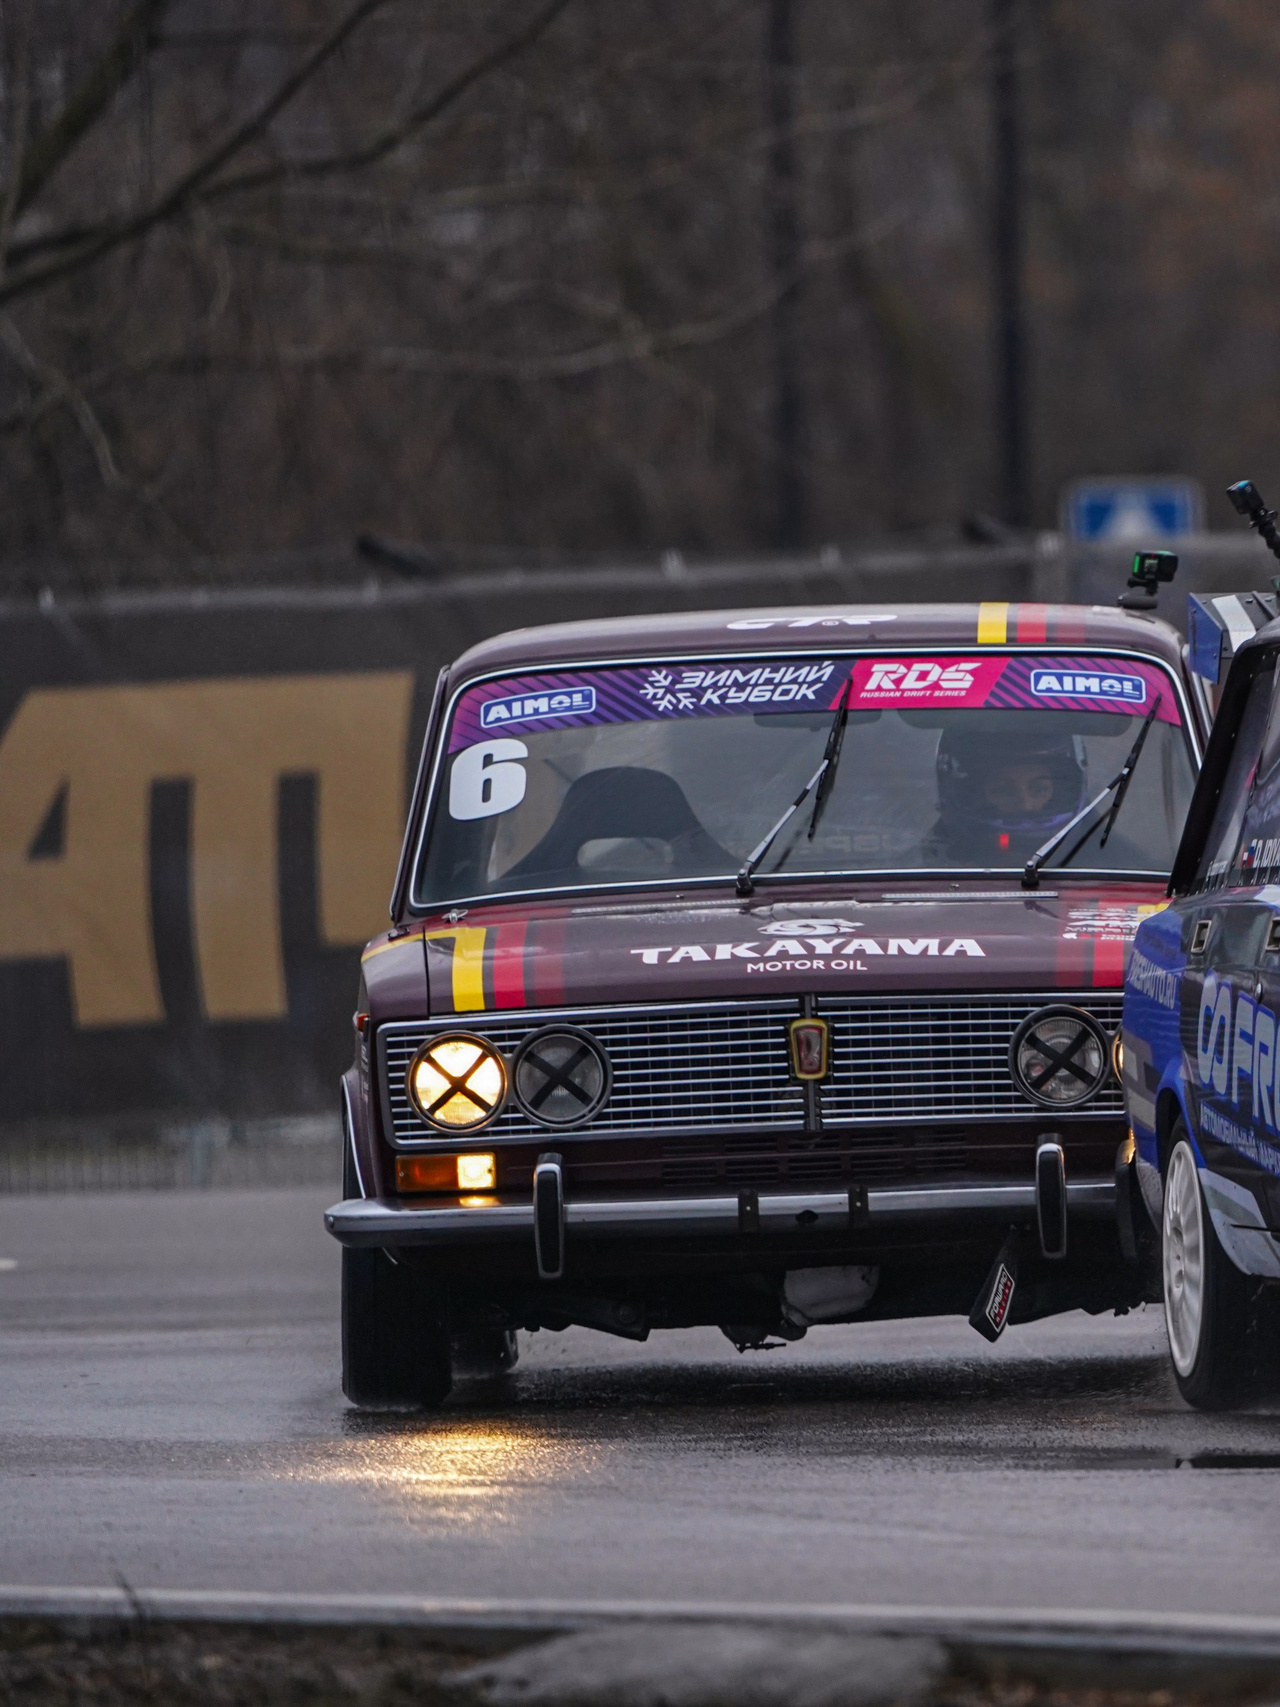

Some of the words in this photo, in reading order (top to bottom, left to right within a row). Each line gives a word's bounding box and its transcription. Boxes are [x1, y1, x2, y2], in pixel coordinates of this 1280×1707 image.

[675, 661, 834, 688] ЗИМНИЙ
[864, 662, 983, 690] RDS
[1036, 675, 1140, 698] AIMOL
[700, 683, 823, 705] КУБОК
[860, 690, 901, 699] RUSSIAN
[904, 690, 932, 698] DRIFT
[933, 689, 967, 698] SERIES
[485, 692, 590, 723] AIMOL
[449, 738, 528, 820] 6
[630, 938, 986, 964] TAKAYAMA
[747, 959, 826, 973] MOTOR
[831, 959, 868, 971] OIL
